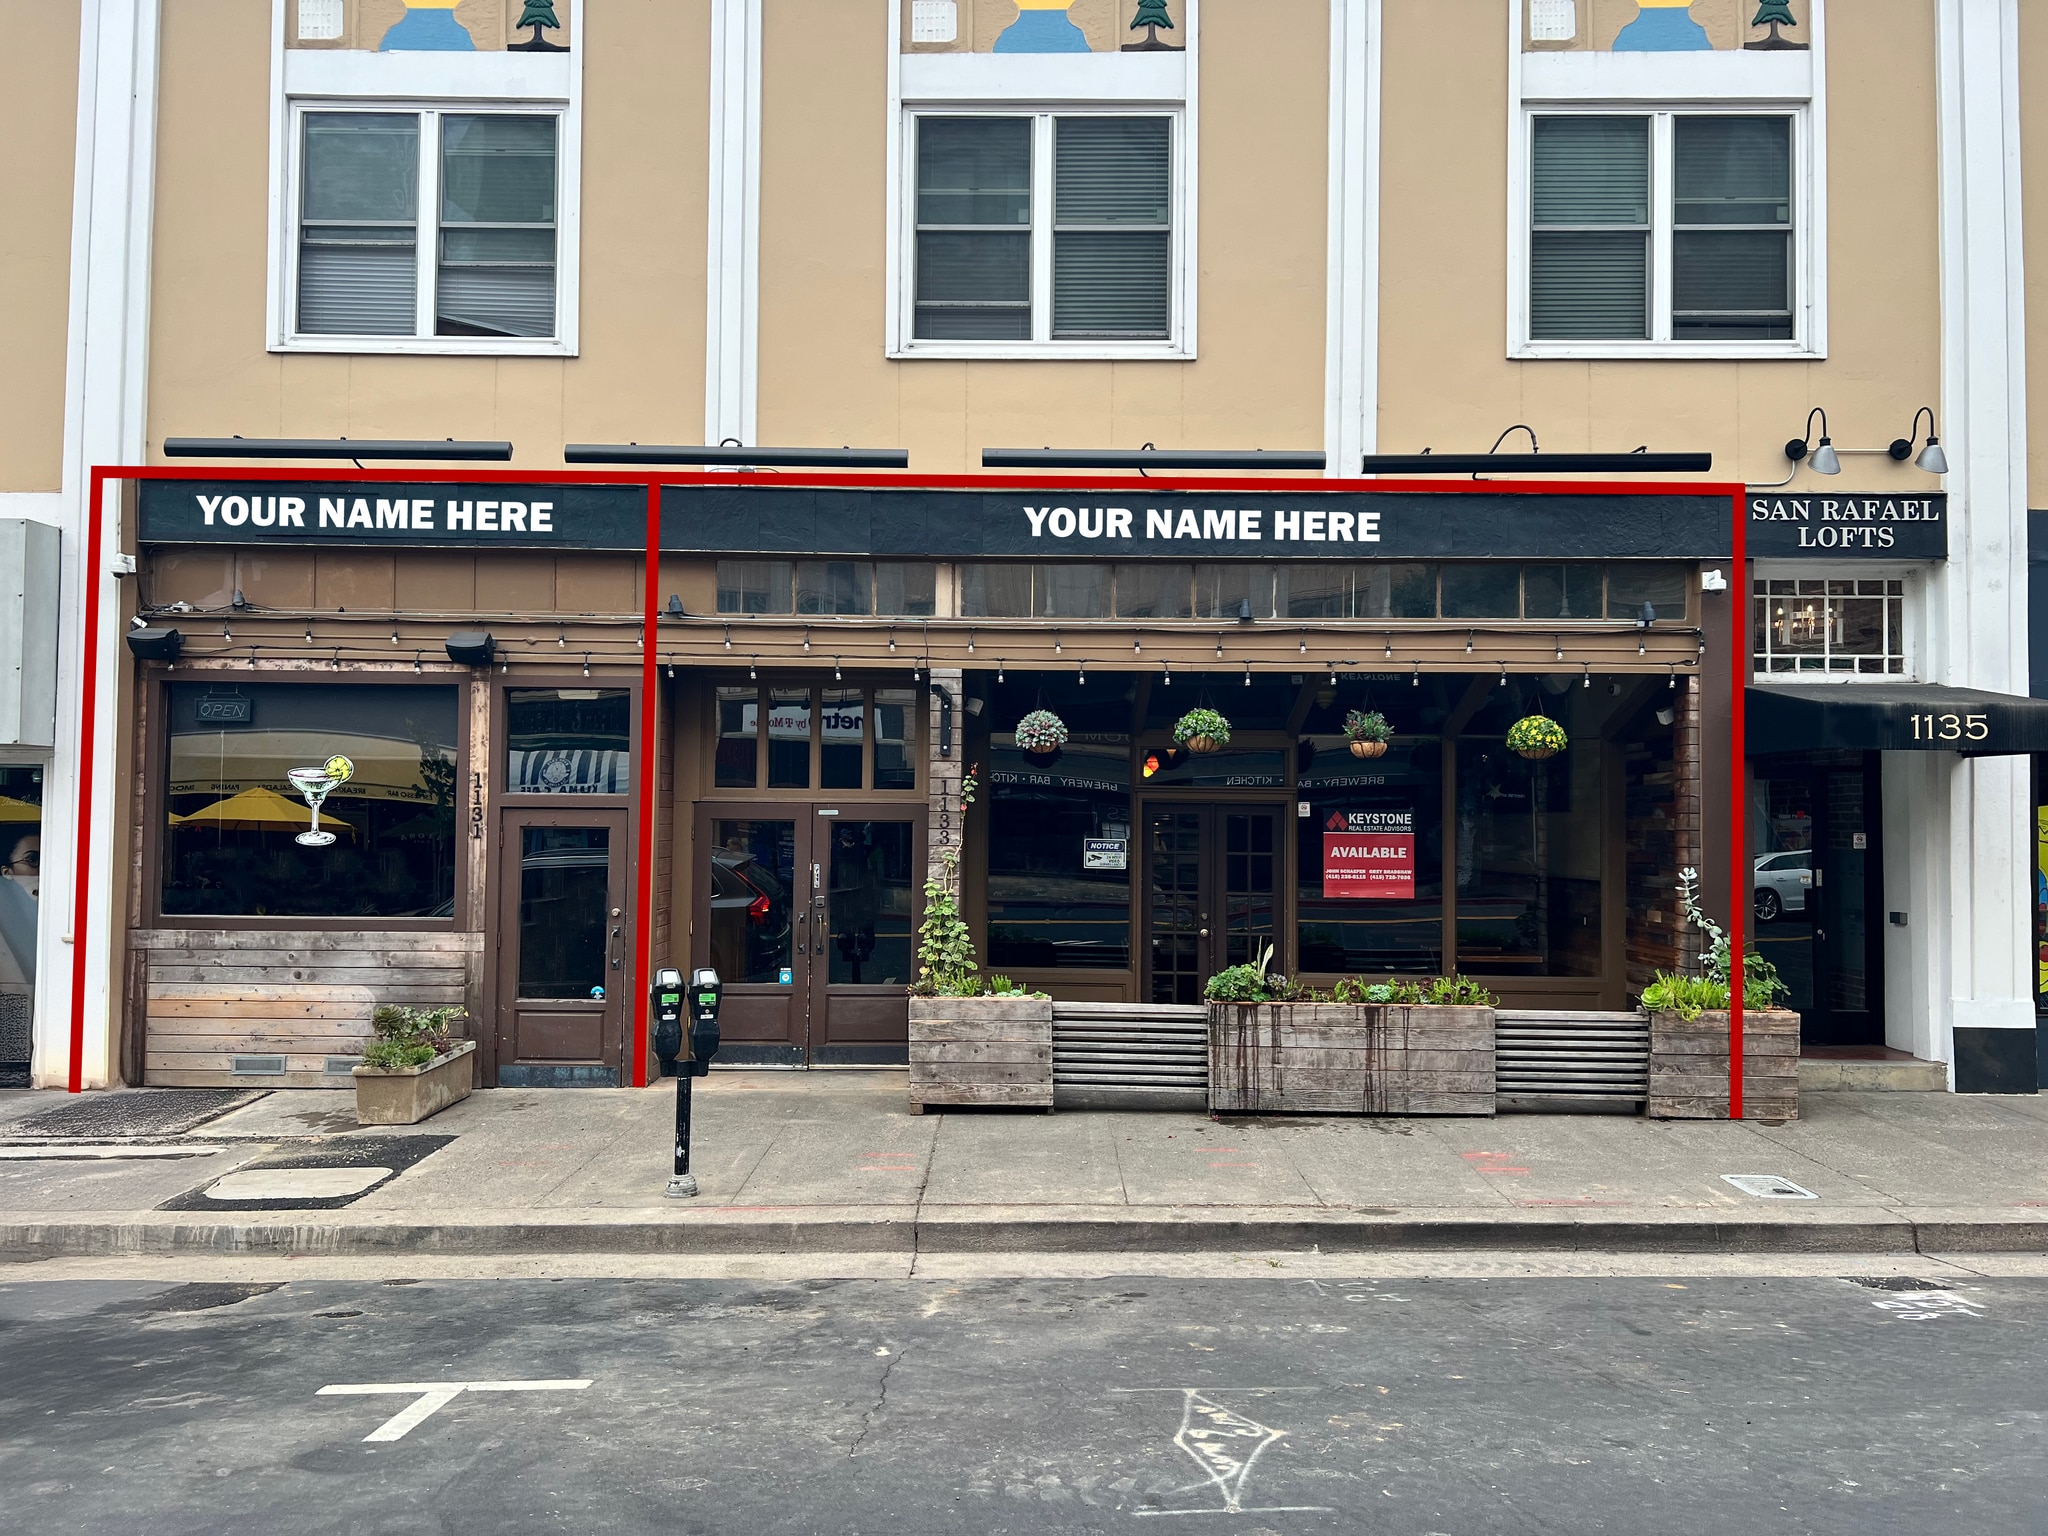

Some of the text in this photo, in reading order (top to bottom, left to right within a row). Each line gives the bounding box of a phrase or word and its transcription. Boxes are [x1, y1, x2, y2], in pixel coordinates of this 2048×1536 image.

[195, 495, 553, 532] YOUR NAME HERE
[1752, 499, 1940, 521] SAN RAFAEL
[1023, 506, 1381, 542] YOUR NAME HERE
[1798, 526, 1895, 548] LOFTS
[200, 703, 246, 718] OPEN
[1910, 714, 1989, 740] 1135
[471, 772, 483, 839] 1131
[939, 779, 950, 845] 1133
[1348, 813, 1412, 824] KEYSTONE
[1090, 842, 1120, 850] NOTICE
[1330, 846, 1407, 858] AVAILABLE
